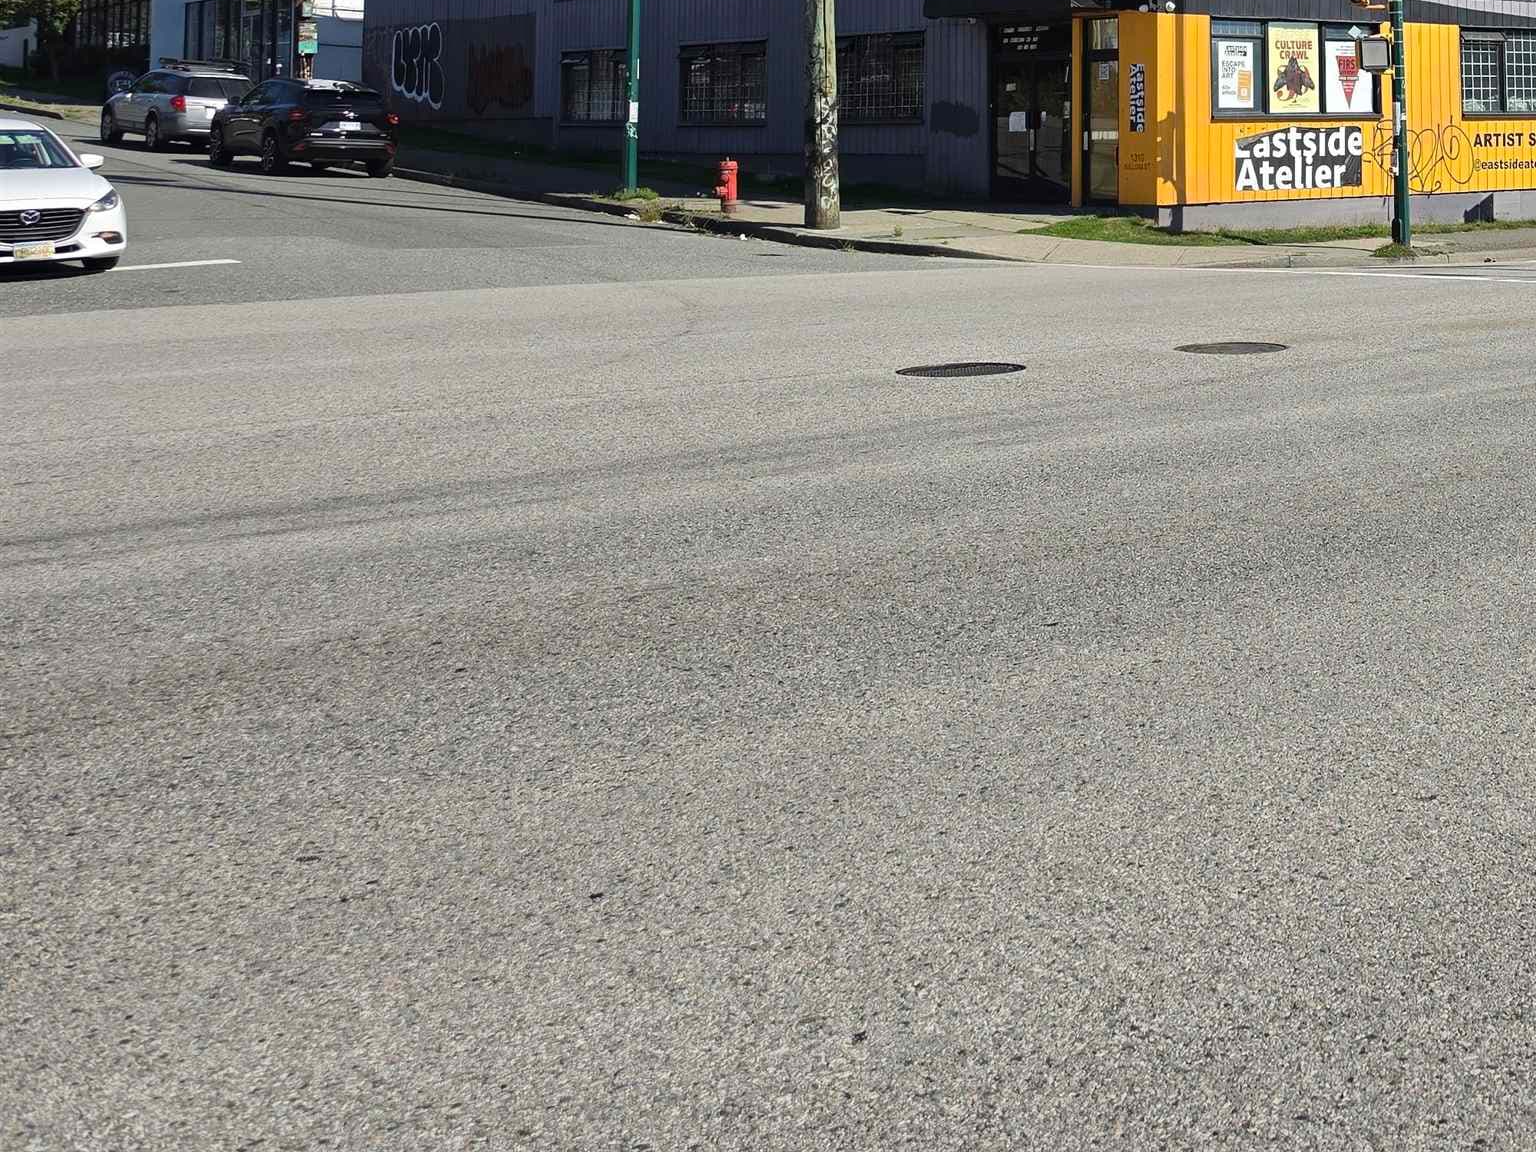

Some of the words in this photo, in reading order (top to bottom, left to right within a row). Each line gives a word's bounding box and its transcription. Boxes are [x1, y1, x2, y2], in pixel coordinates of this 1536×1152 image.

[1275, 40, 1313, 50] CULTURE
[1280, 50, 1309, 60] CRAWL
[1339, 58, 1356, 70] FIRS
[1128, 64, 1137, 123] Atelier
[1137, 63, 1146, 135] Eastside
[1473, 132, 1524, 148] ARTIST
[1236, 153, 1346, 192] Atelier
